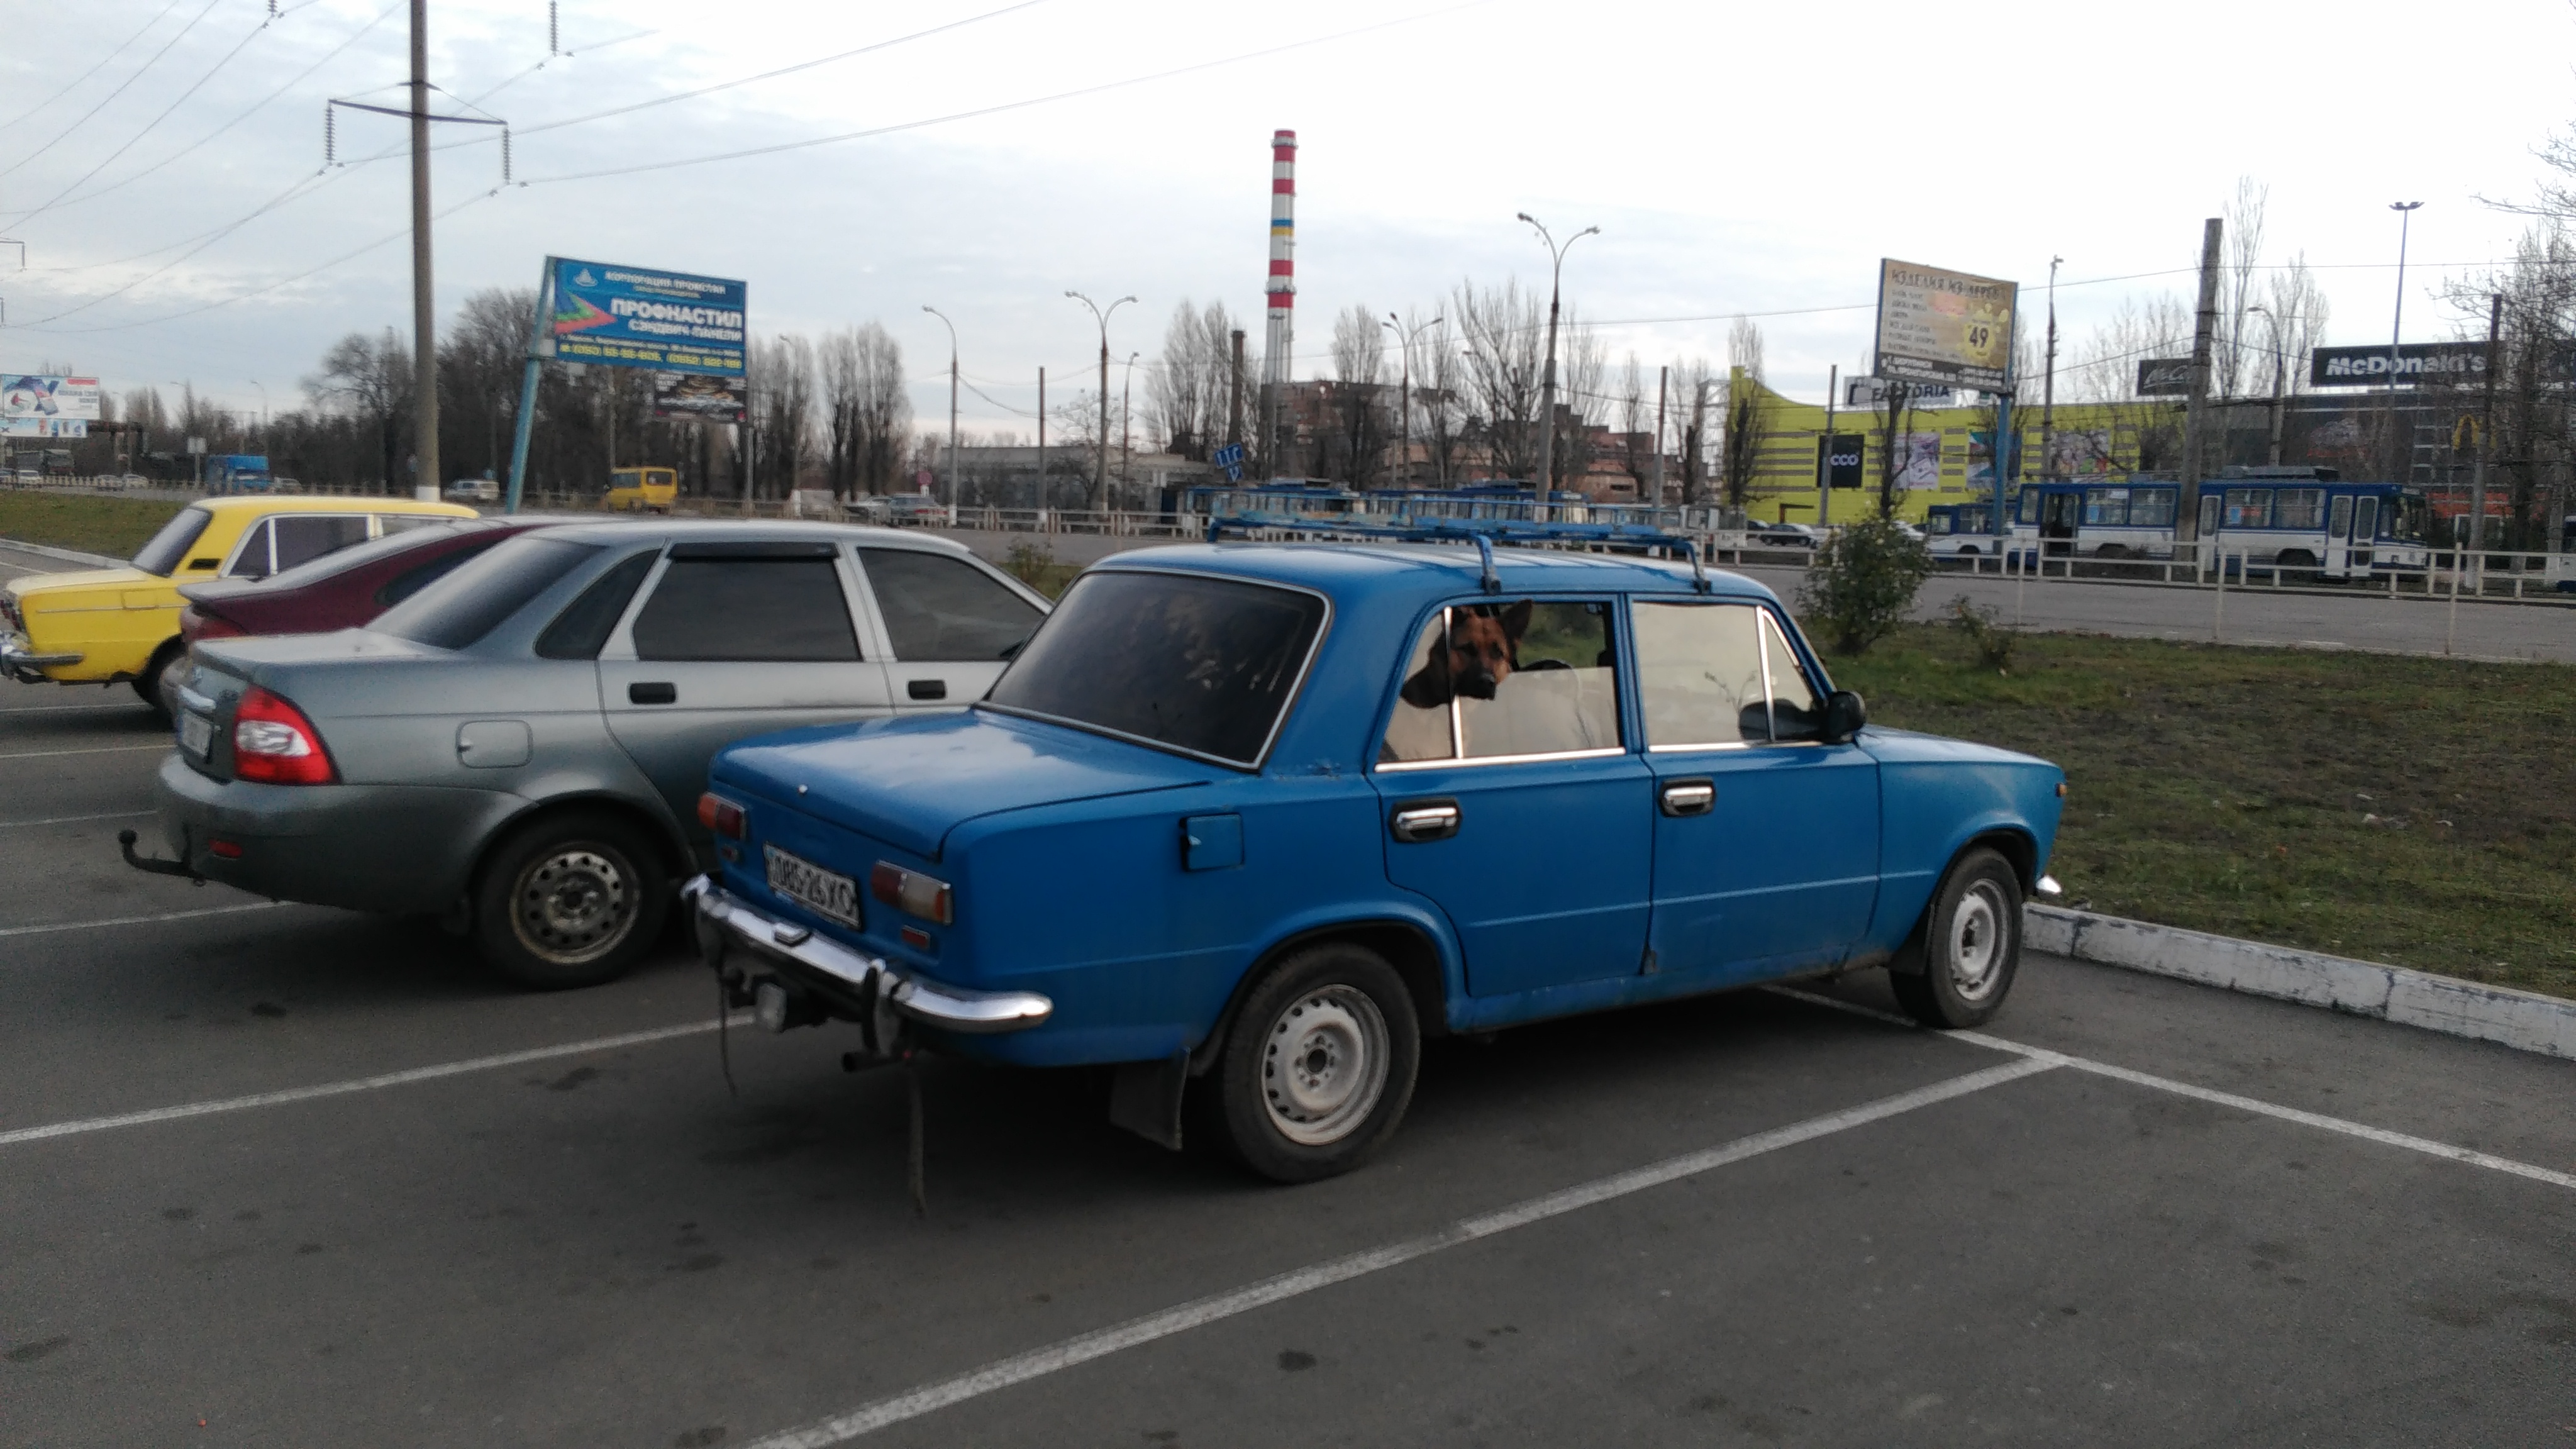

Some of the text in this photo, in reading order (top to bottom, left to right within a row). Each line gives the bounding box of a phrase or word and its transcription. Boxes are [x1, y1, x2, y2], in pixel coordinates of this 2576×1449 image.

[611, 298, 742, 328] ПРОФНАСТИЛ
[1969, 326, 1989, 348] 49
[2326, 353, 2487, 375] McDonald's
